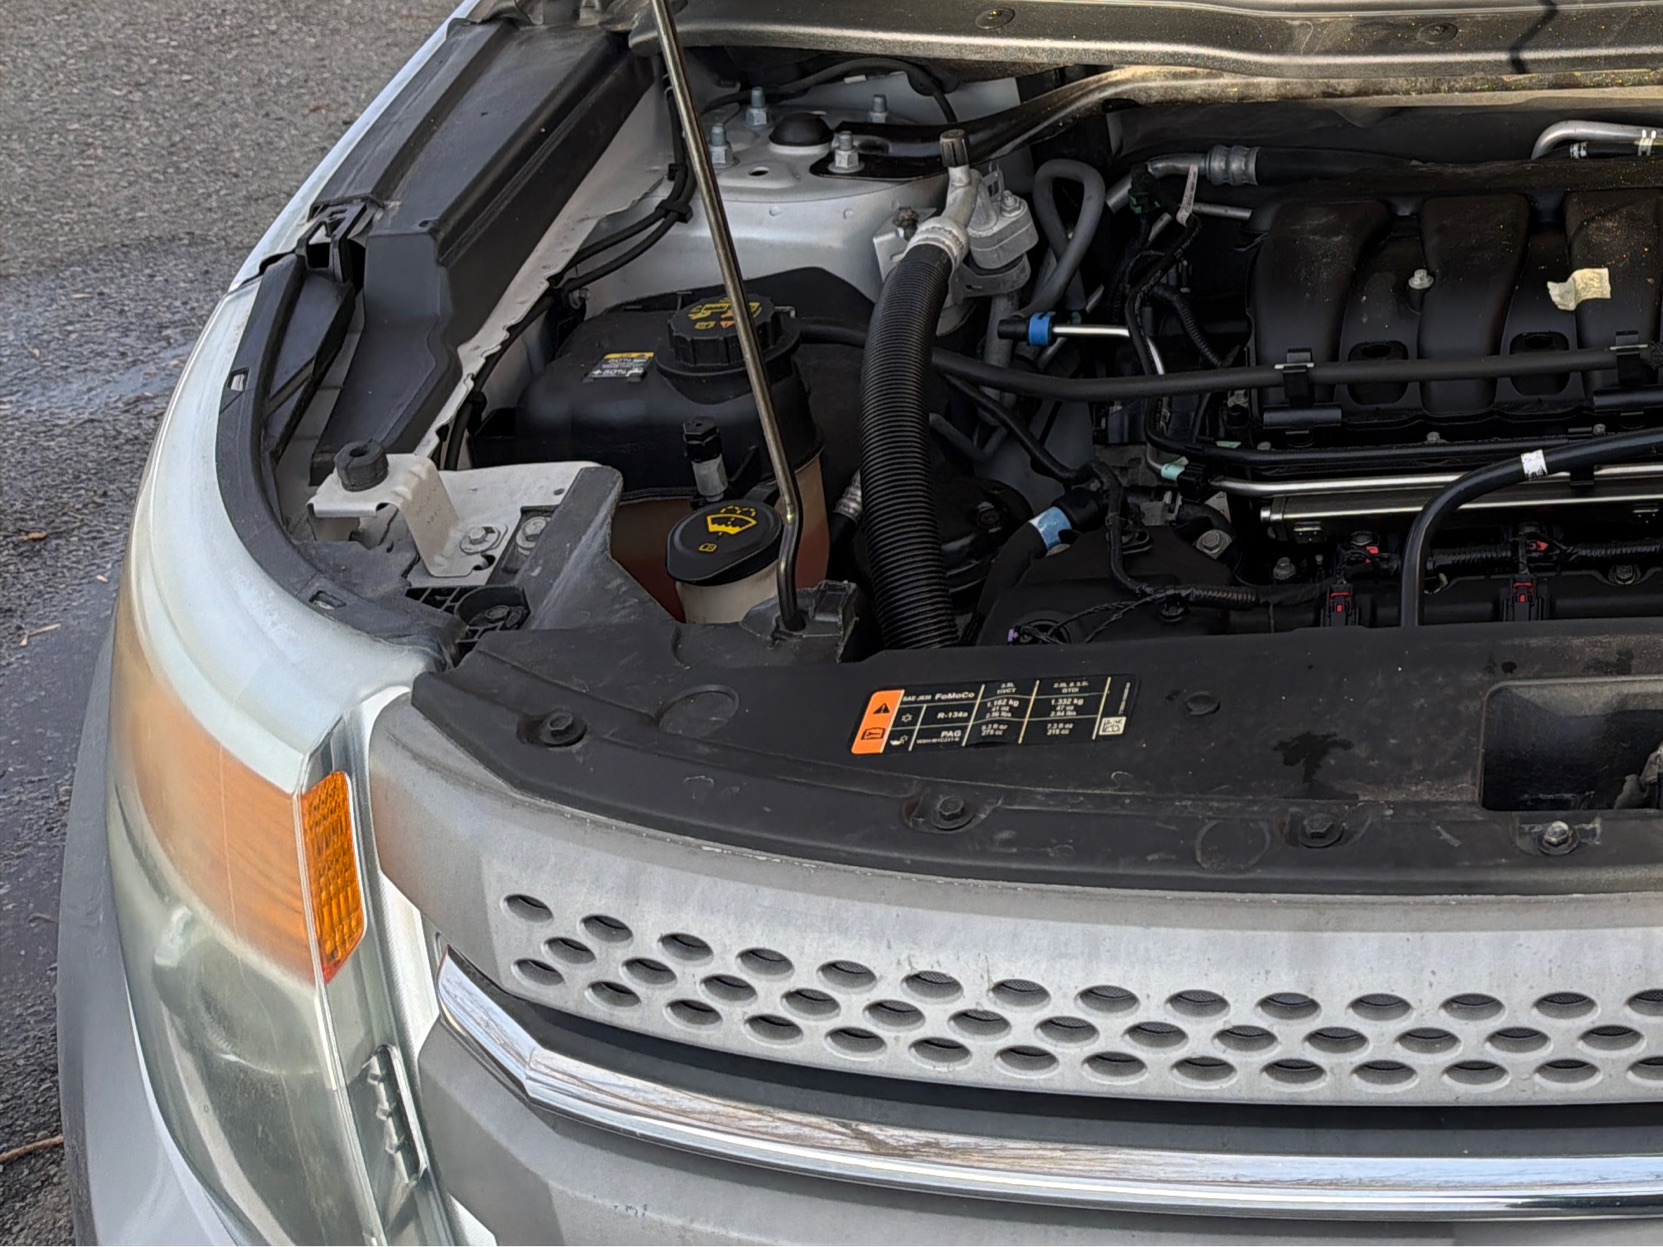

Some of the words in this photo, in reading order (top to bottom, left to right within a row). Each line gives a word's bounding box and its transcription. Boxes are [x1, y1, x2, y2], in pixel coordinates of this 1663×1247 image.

[935, 691, 975, 701] FoMoCo
[1009, 698, 1020, 707] kg
[1050, 698, 1072, 706] 1.332
[1073, 698, 1084, 706] kg
[936, 710, 969, 719] R-134a
[940, 729, 962, 738] PAG
